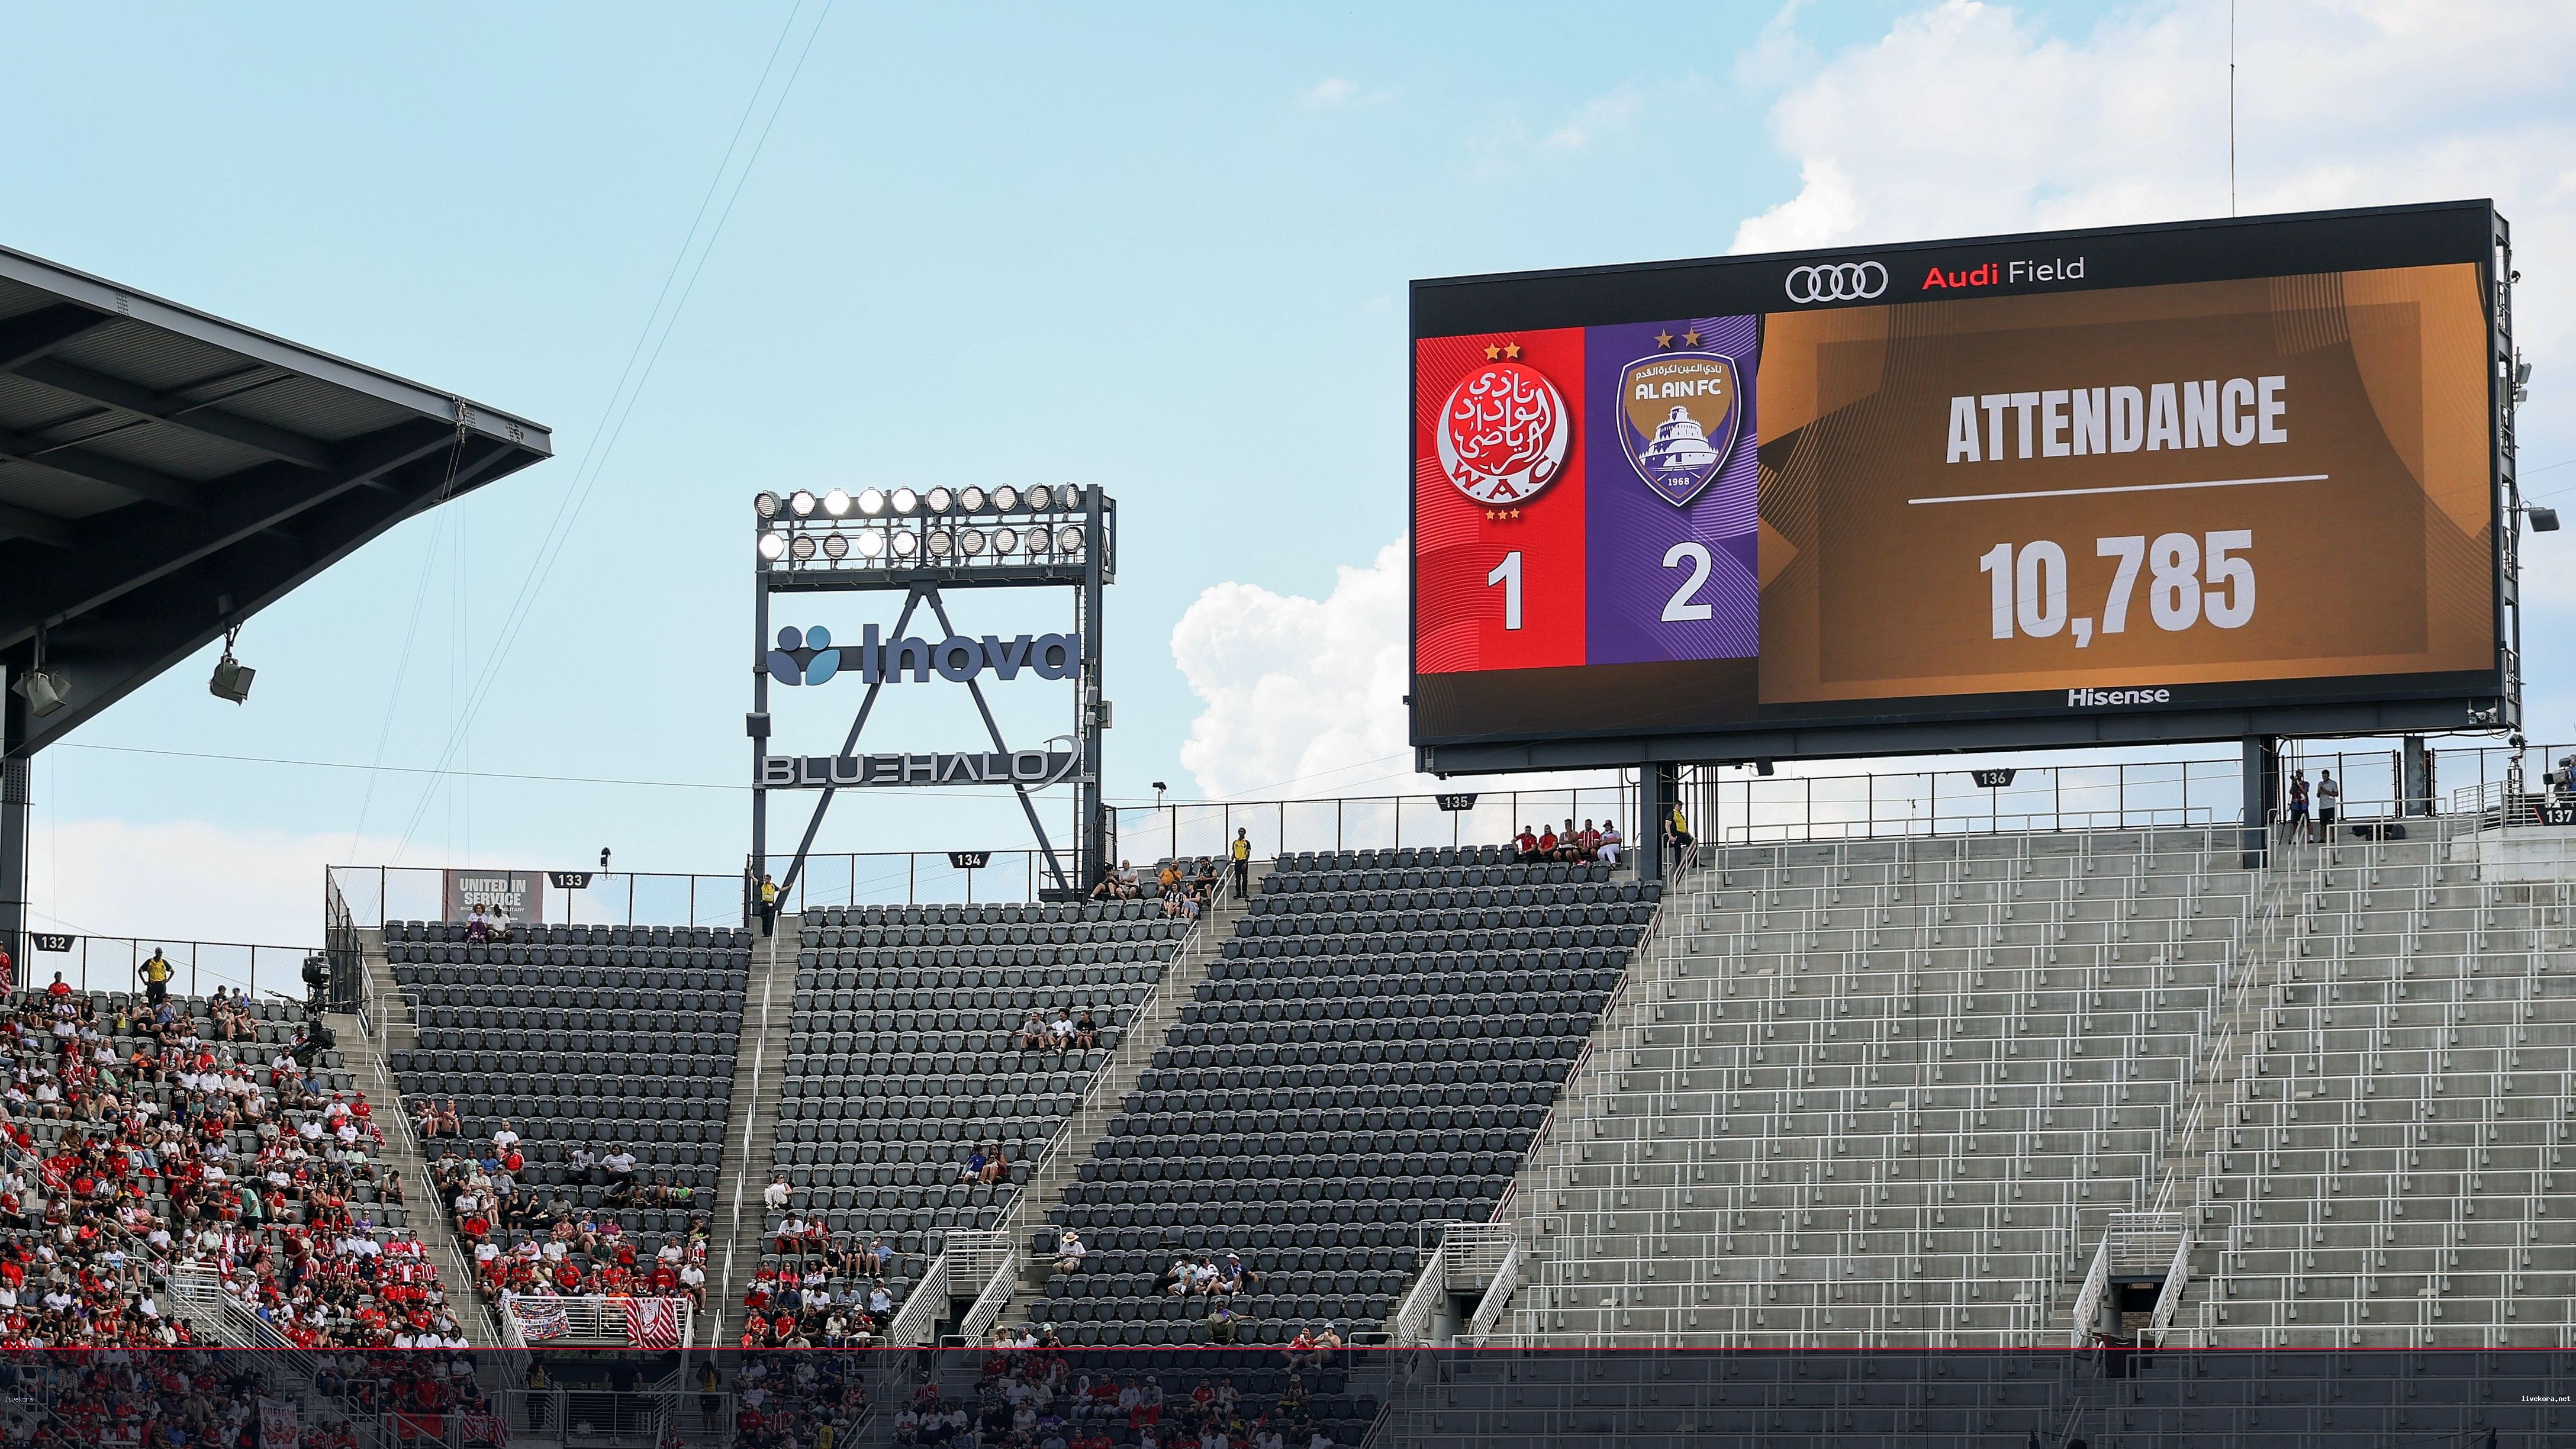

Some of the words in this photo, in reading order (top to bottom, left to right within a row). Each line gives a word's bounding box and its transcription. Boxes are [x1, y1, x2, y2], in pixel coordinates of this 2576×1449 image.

[1922, 263, 1998, 289] Audi
[2009, 256, 2084, 284] Field
[1635, 383, 1659, 400] AL
[1661, 381, 1694, 398] AIN
[1697, 378, 1721, 395] FC
[1946, 375, 2288, 463] ATTENDANCE
[1667, 477, 1690, 487] 1968
[1487, 550, 1522, 630] 1
[1661, 541, 1712, 622] 2
[1980, 529, 2256, 649] 10,785
[862, 623, 1081, 684] Inova
[2067, 688, 2171, 707] Hisense
[762, 749, 1049, 785] BLUEHALO
[1982, 772, 2006, 785] 136
[1445, 796, 1468, 808] 135
[2546, 809, 2573, 823] 137
[957, 854, 981, 866] 134
[459, 878, 508, 892] UNITED
[511, 879, 526, 893] IN
[558, 874, 582, 887] 133
[464, 892, 521, 906] SERVICE
[41, 936, 65, 949] 132
